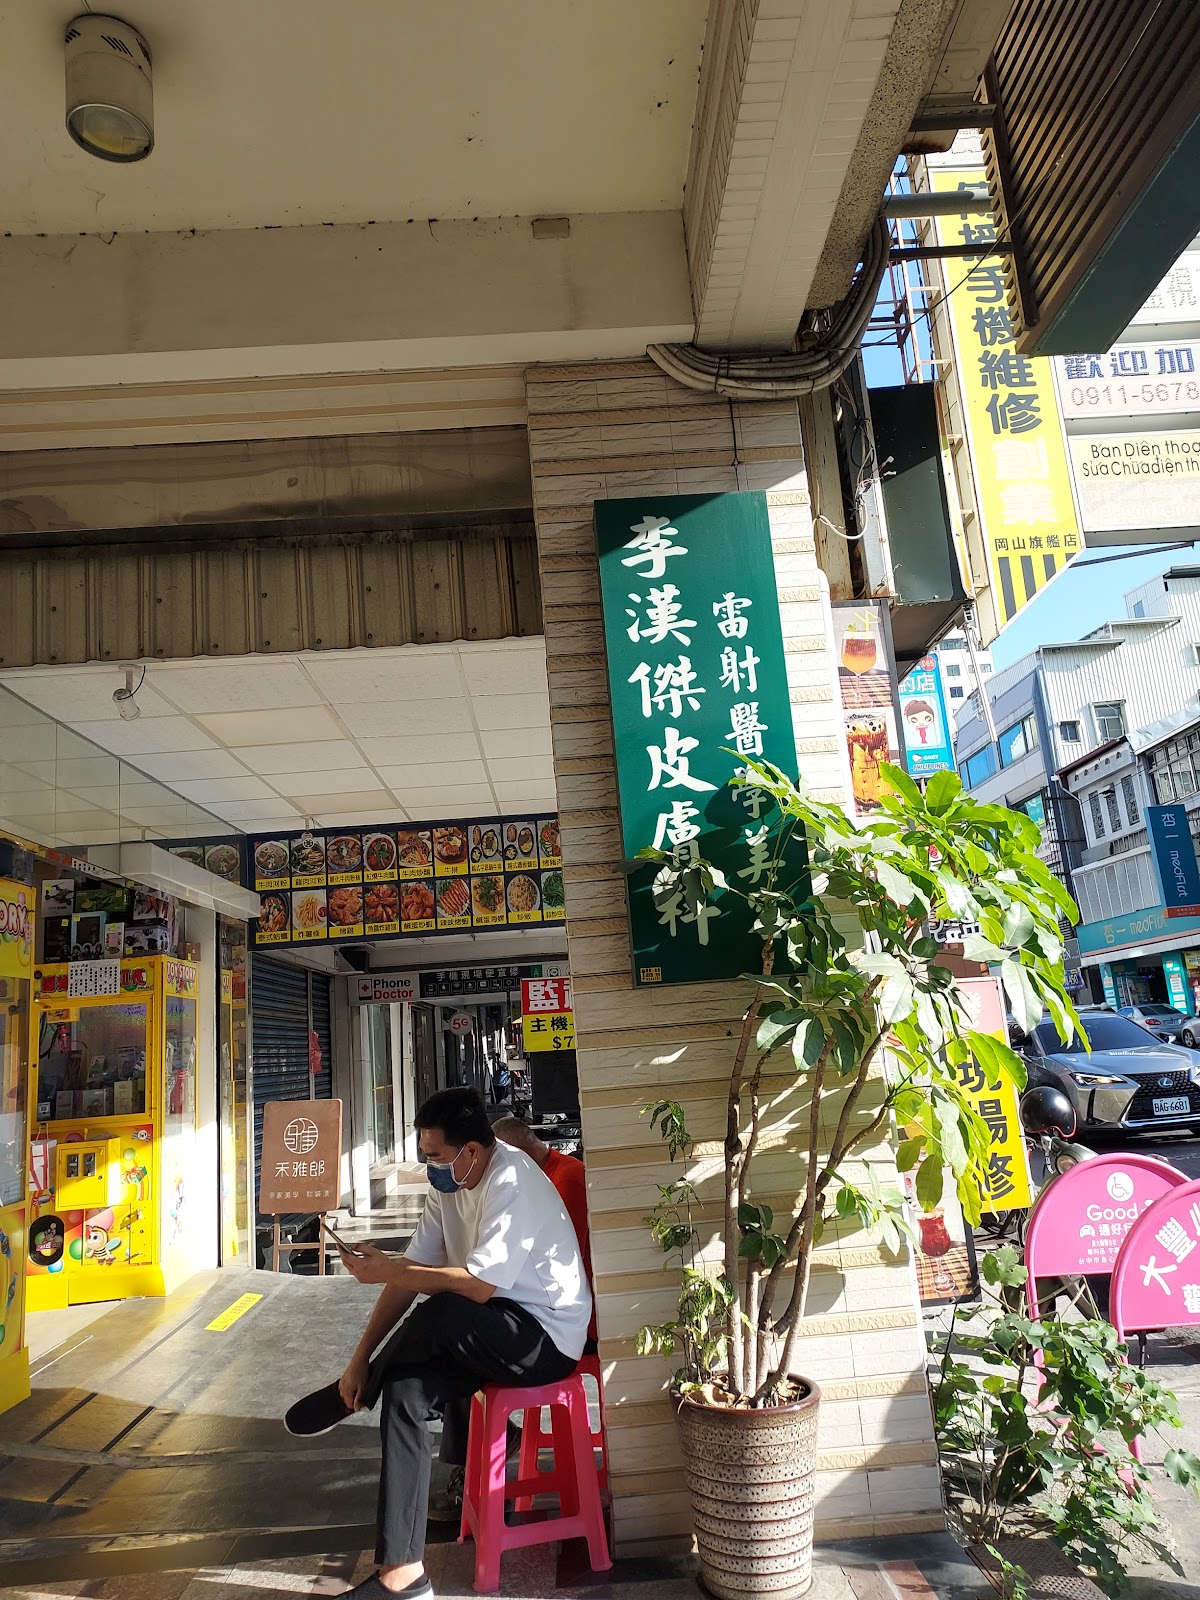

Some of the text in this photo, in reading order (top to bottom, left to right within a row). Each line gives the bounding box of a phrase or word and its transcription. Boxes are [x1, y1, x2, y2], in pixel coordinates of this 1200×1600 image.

[994, 533, 1077, 552] 岡山旗艦店
[621, 516, 721, 945] 李漢傑皮膚科
[713, 591, 787, 940] 雷射醫學美
[373, 978, 411, 989] Phone
[373, 988, 414, 1000] Doctor
[452, 1018, 469, 1030] 5G
[274, 1160, 325, 1178] 禾雅郎
[1086, 1202, 1138, 1222] Good
[1140, 1201, 1200, 1296] 大豐
